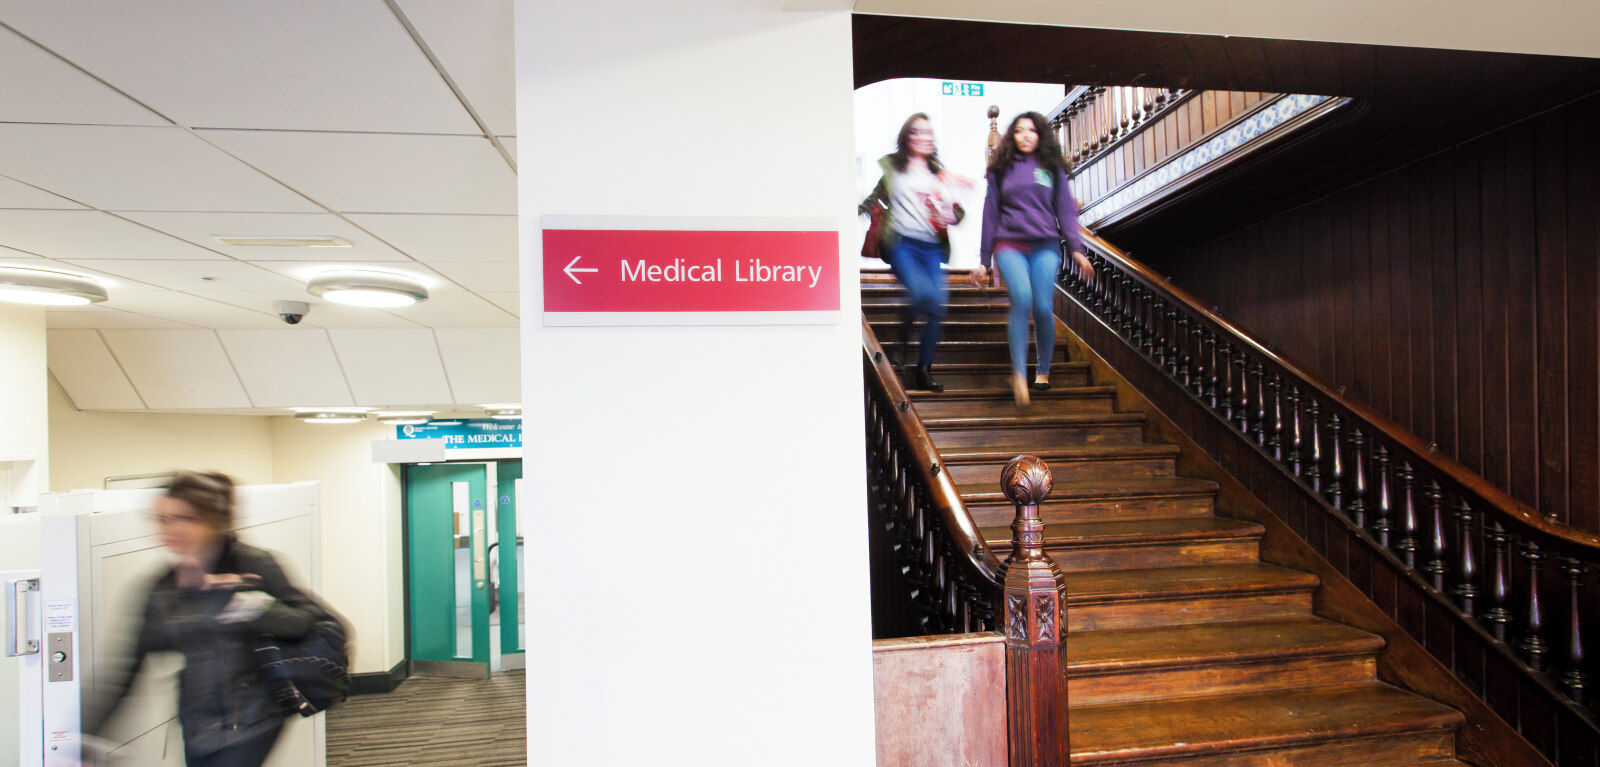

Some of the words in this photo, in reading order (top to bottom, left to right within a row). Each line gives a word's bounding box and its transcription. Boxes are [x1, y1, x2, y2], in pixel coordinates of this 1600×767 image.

[621, 258, 722, 282] Medical
[735, 258, 823, 288] Library
[443, 435, 464, 443] THE
[468, 434, 515, 443] MEDICAL
